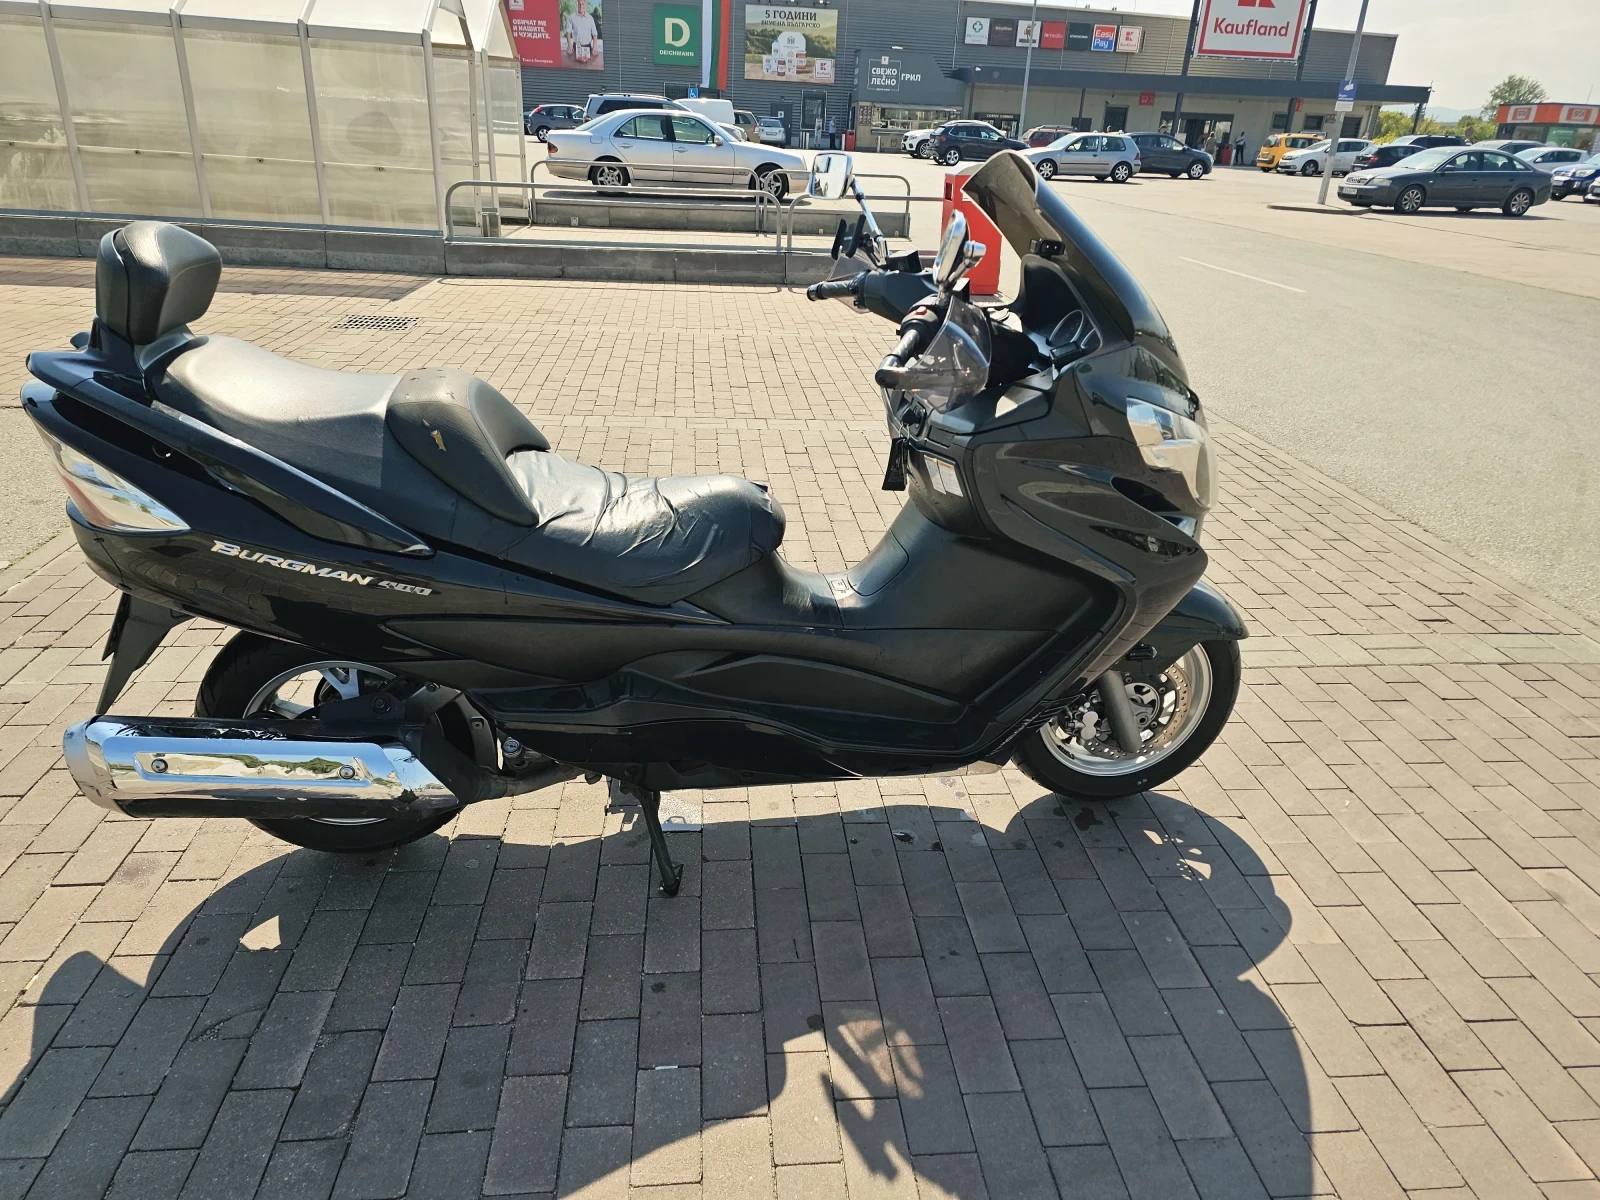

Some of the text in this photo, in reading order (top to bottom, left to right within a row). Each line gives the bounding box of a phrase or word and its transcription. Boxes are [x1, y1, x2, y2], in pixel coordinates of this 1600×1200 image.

[765, 9, 817, 21] 5 ГОДИНИ
[787, 21, 821, 29] БЪЛГАРСКО
[1213, 17, 1290, 37] Kaufland
[664, 17, 691, 48] D
[1095, 29, 1114, 39] Easy
[1094, 38, 1109, 49] Pay
[659, 49, 694, 57] DEICHMANN
[871, 67, 898, 76] СВЕЖО
[871, 77, 897, 86] ЛЕСНО
[901, 73, 921, 81] ГРИЛ
[210, 540, 433, 596] BURGMAN 400
